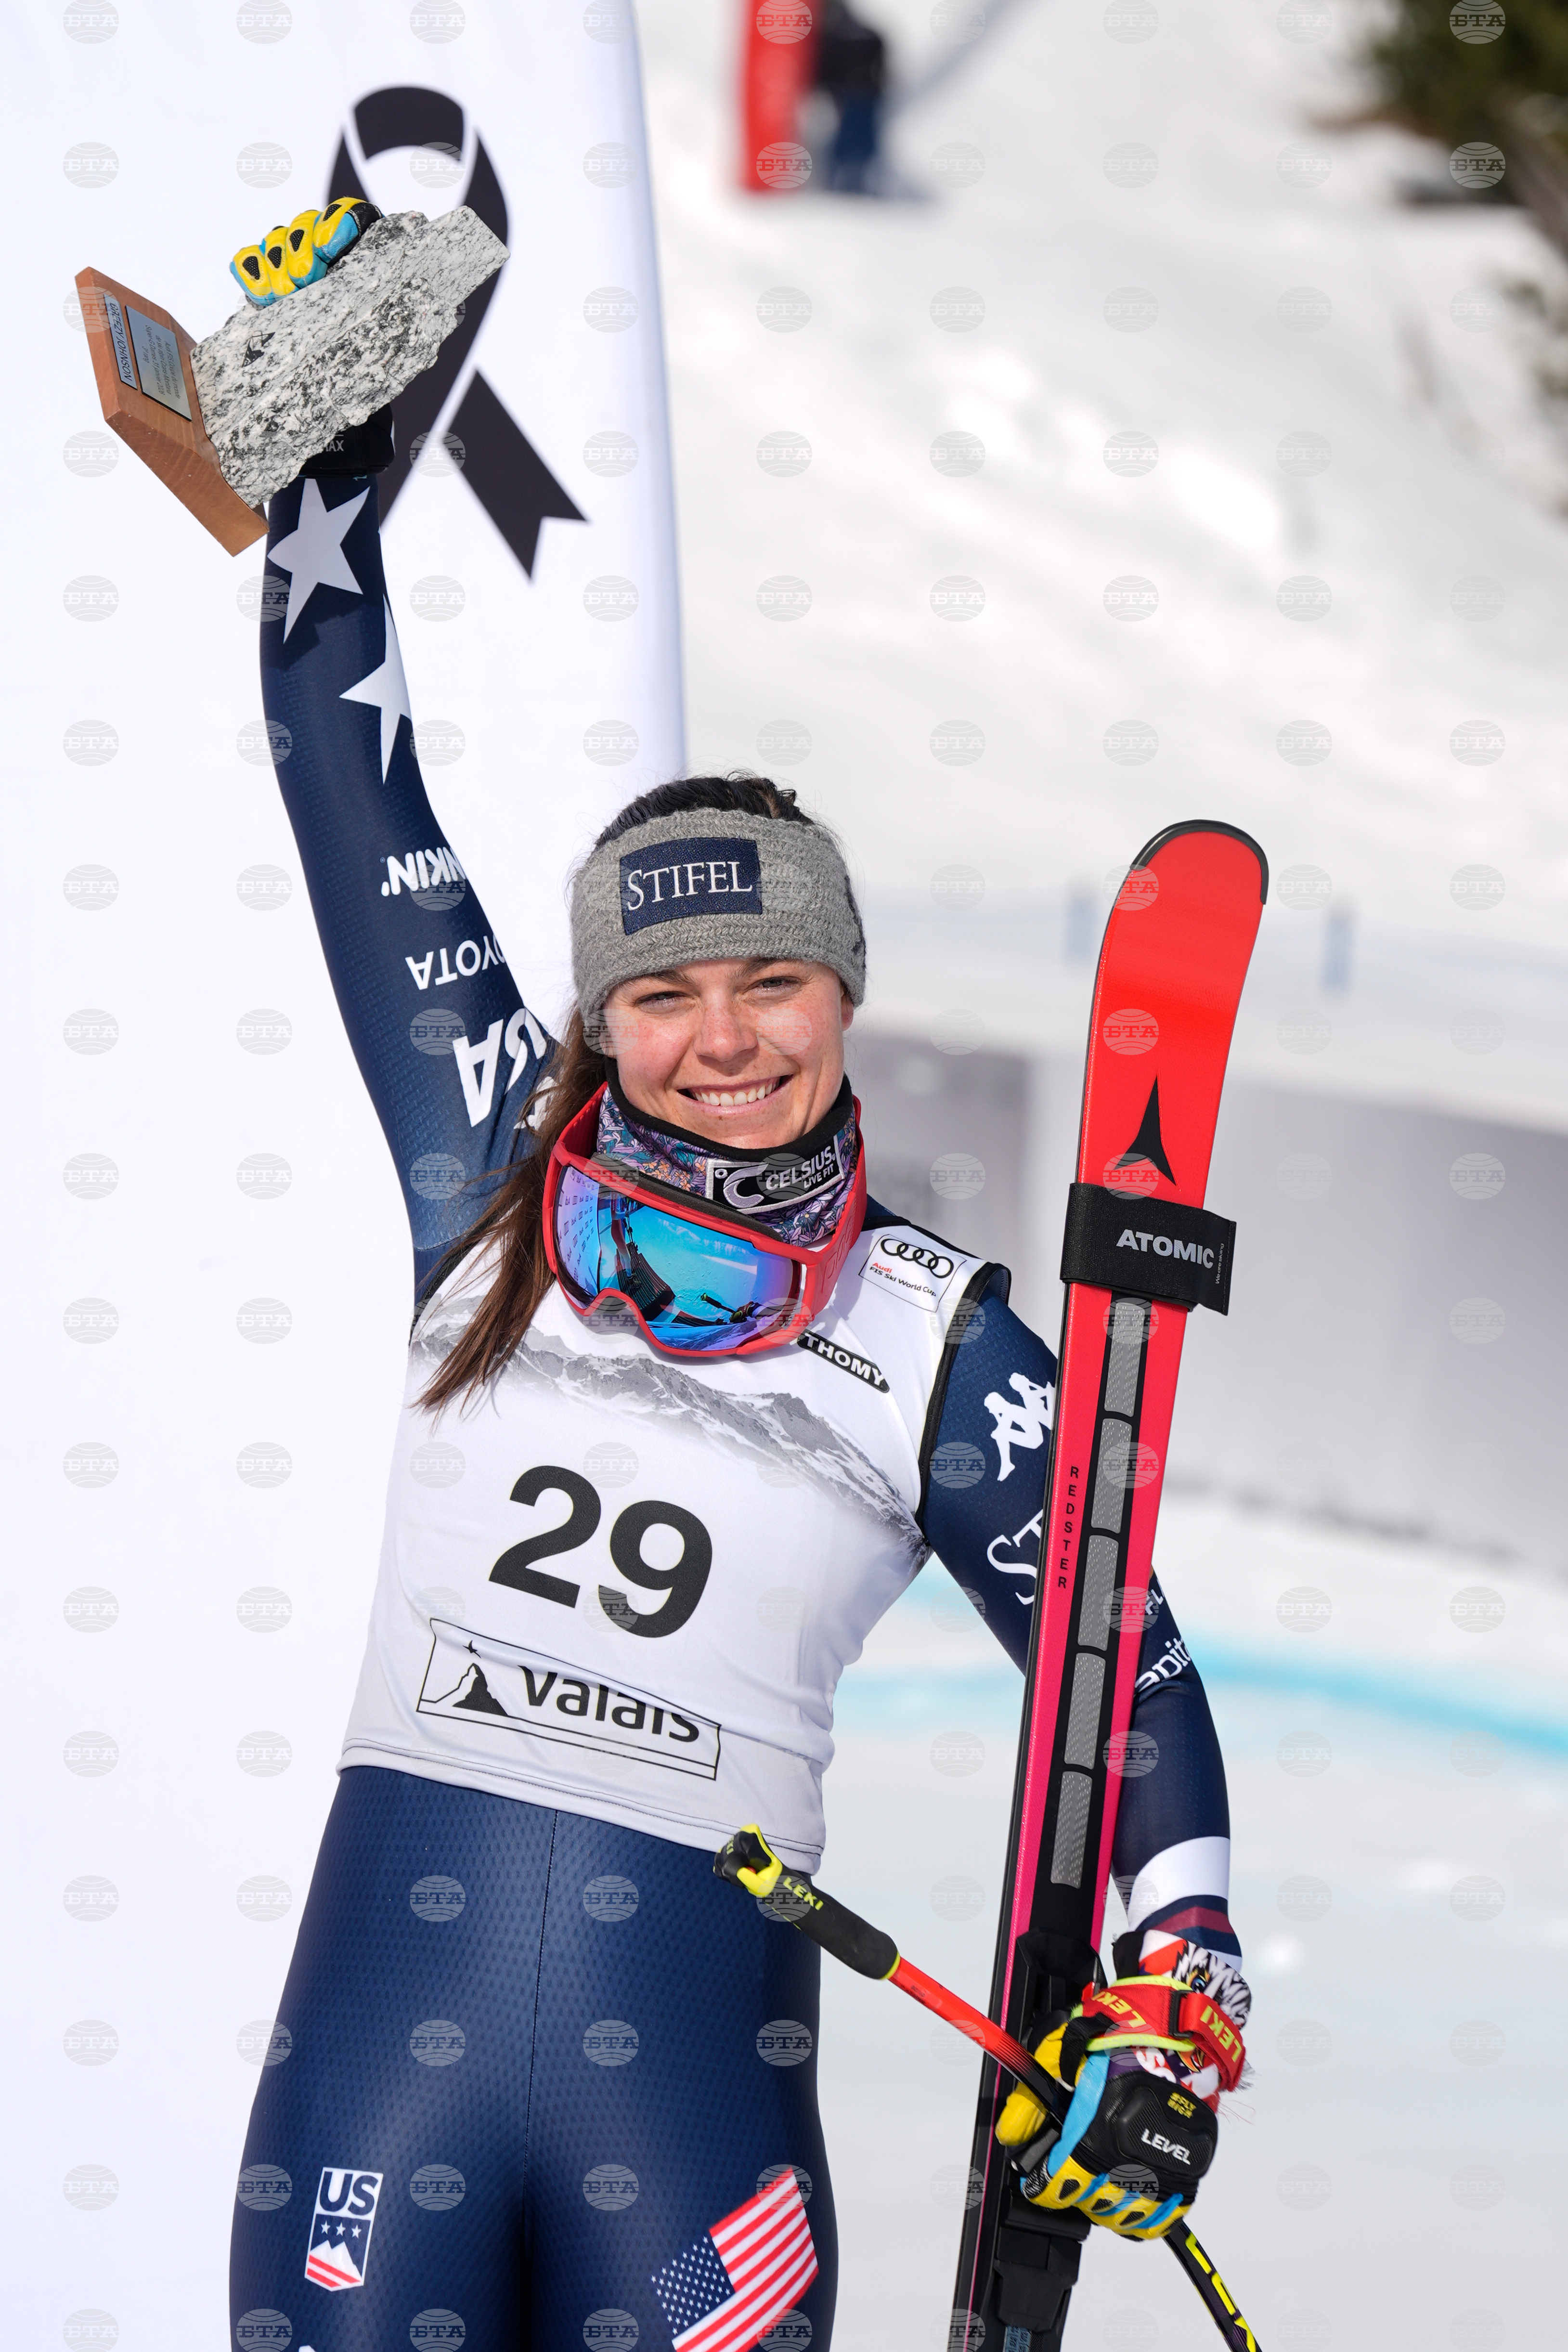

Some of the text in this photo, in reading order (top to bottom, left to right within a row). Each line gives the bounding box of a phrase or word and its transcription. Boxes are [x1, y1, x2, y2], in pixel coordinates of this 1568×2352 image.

[109, 301, 133, 382] BREEZY JOHNSON
[626, 861, 752, 911] STIFEL
[803, 1164, 834, 1189] LIVE FIT
[872, 1262, 893, 1273] Audi
[1115, 1229, 1214, 1269] ATOMIC
[869, 1266, 937, 1297] FIS Ski World Cup
[804, 1331, 886, 1388] THOMY
[1057, 1465, 1079, 1589] REDSTER
[488, 1465, 713, 1638] 29
[782, 1877, 824, 1911] LEKI
[1091, 1990, 1147, 2028] LEKI
[1200, 2004, 1243, 2063] LEKI
[1141, 2128, 1191, 2166] LEVEL
[319, 2170, 379, 2216] US
